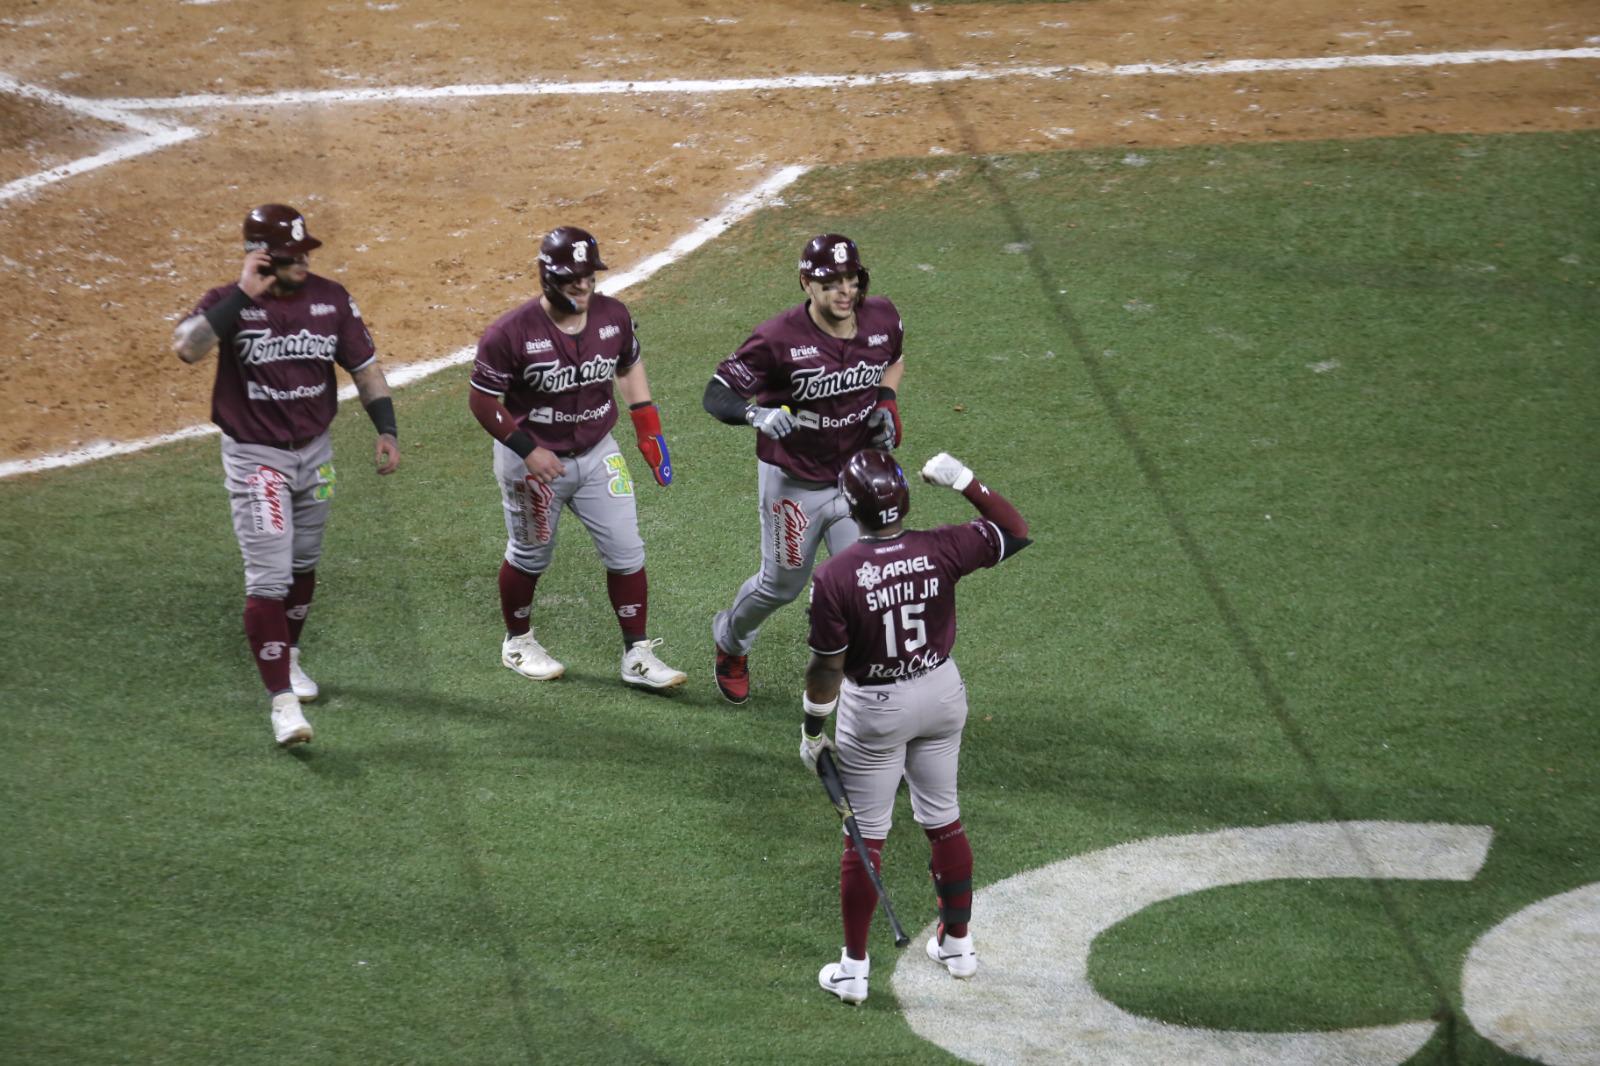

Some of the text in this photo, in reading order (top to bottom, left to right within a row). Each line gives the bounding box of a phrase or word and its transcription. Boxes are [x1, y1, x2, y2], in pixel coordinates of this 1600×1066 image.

[790, 345, 818, 359] Brück
[879, 506, 899, 525] 15
[781, 499, 808, 567] Caliente
[882, 556, 934, 580] ARIEL
[866, 578, 939, 611] SMITH JR
[882, 602, 927, 658] 15
[867, 660, 906, 678] Red
